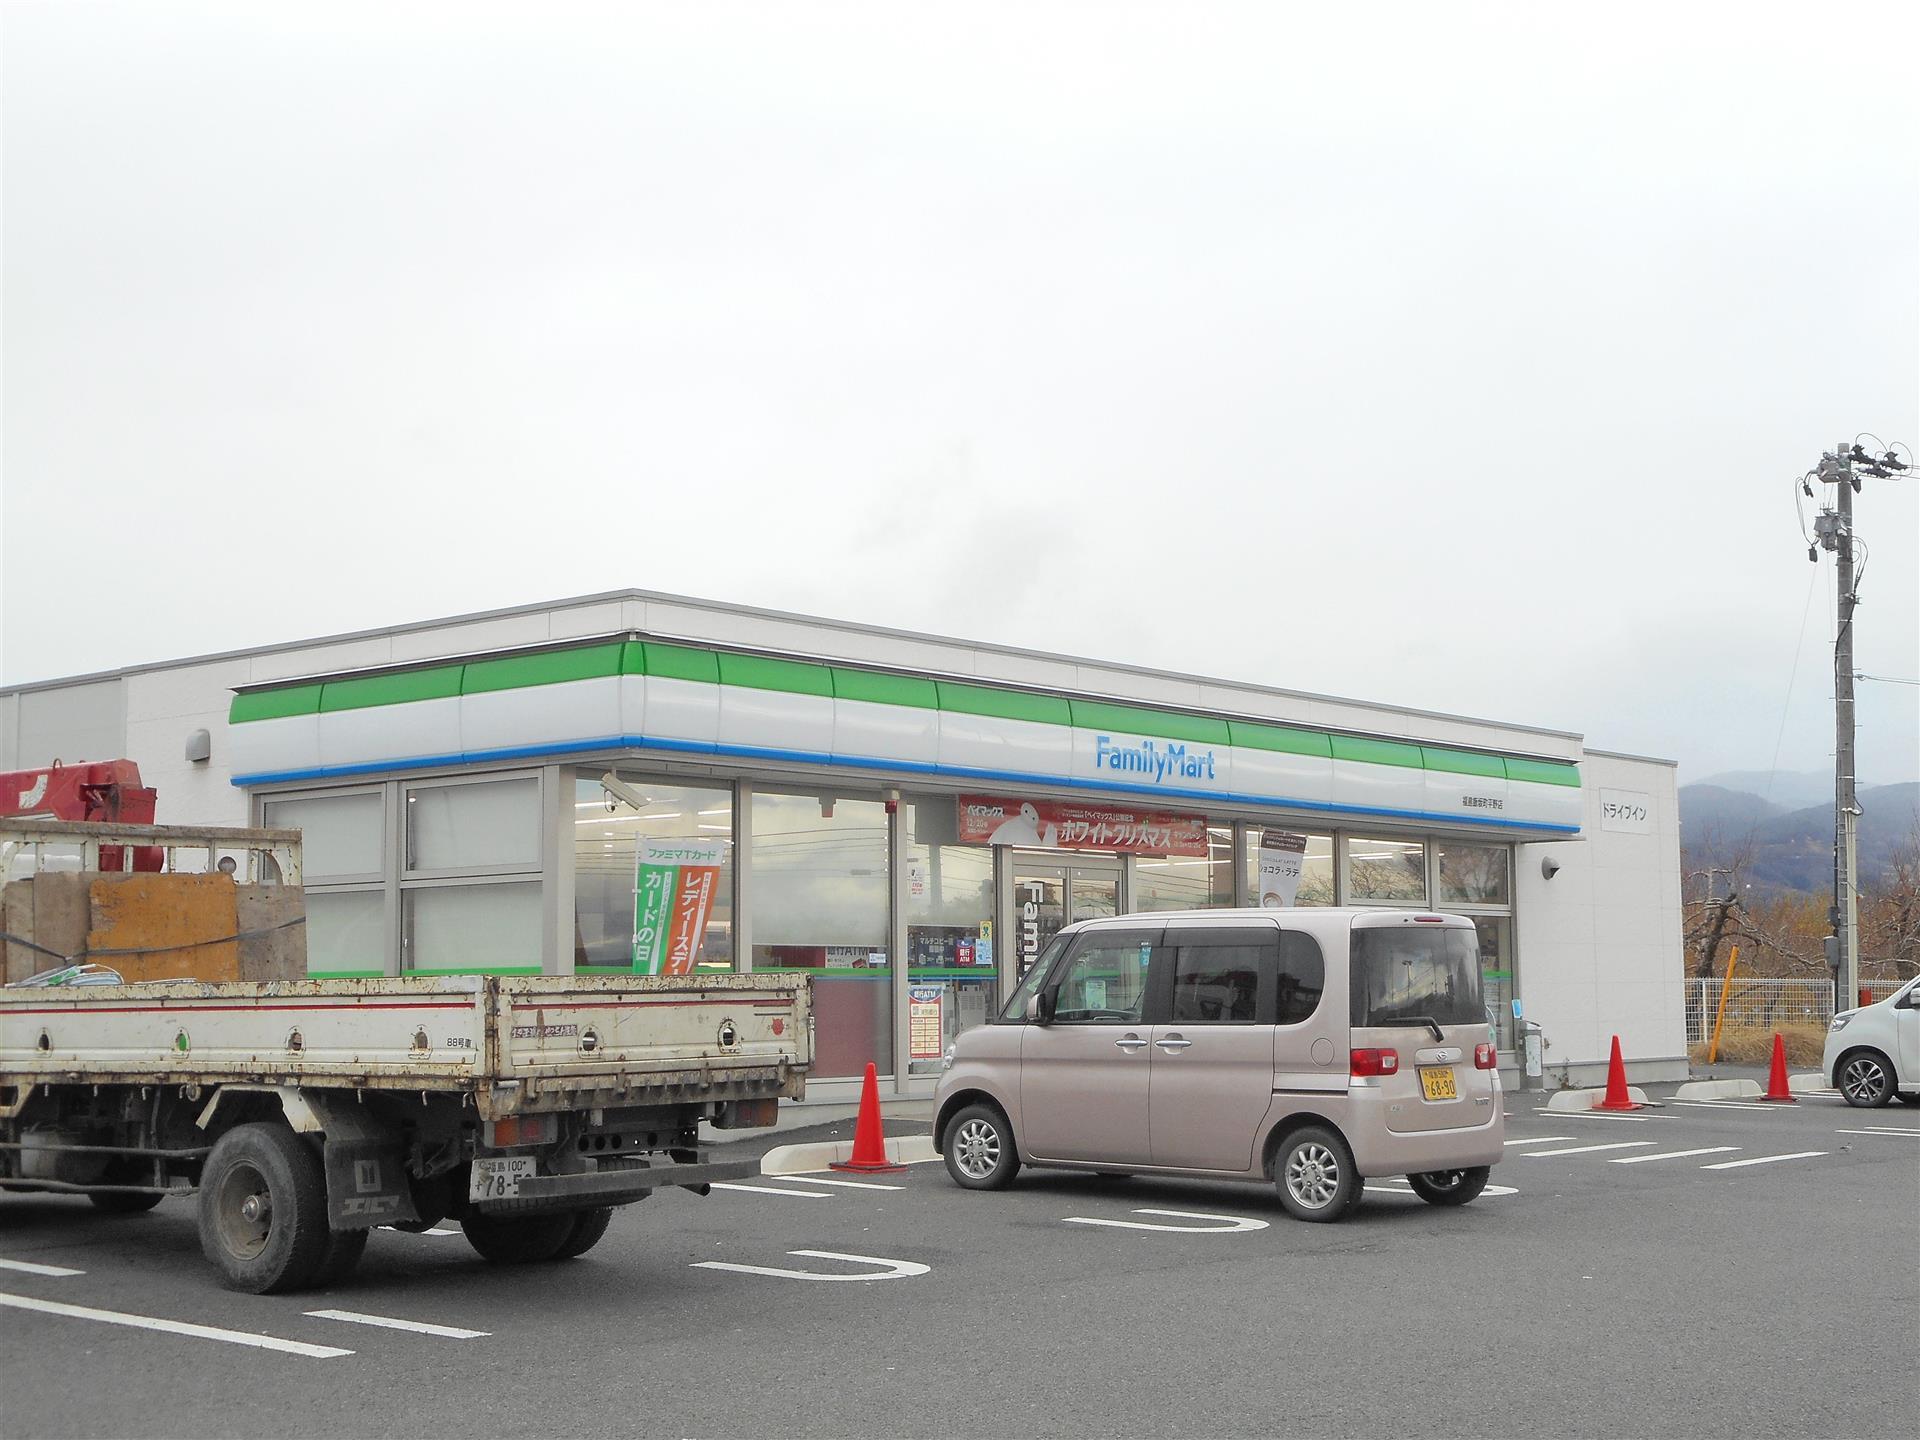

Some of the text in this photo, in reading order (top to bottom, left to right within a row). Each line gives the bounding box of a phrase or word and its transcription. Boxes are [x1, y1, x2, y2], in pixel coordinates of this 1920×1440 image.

[1096, 735, 1215, 783] FamilyMart
[1603, 802, 1647, 821] ドライブイン
[1060, 819, 1172, 849] ホワイトクリスマス
[636, 870, 662, 961] カードの日
[447, 1037, 472, 1048] 88号車
